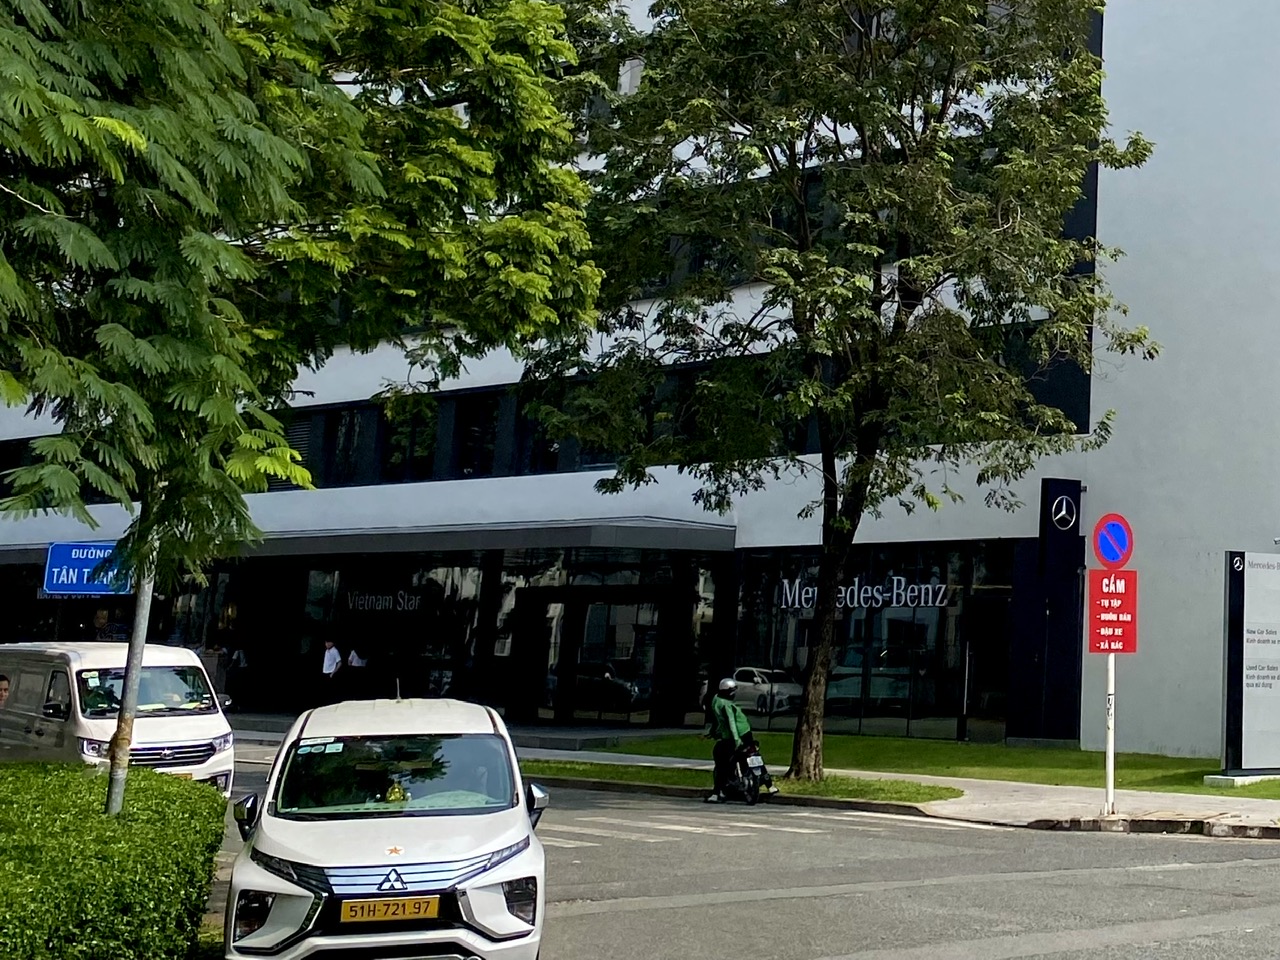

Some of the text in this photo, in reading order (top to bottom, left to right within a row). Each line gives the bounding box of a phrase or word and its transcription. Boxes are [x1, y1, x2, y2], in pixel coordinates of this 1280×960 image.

[52, 565, 78, 584] TÂN
[347, 590, 421, 611] Vietnam Star
[780, 576, 948, 609] Meredes-Benz
[349, 901, 430, 918] 51H-721.97
